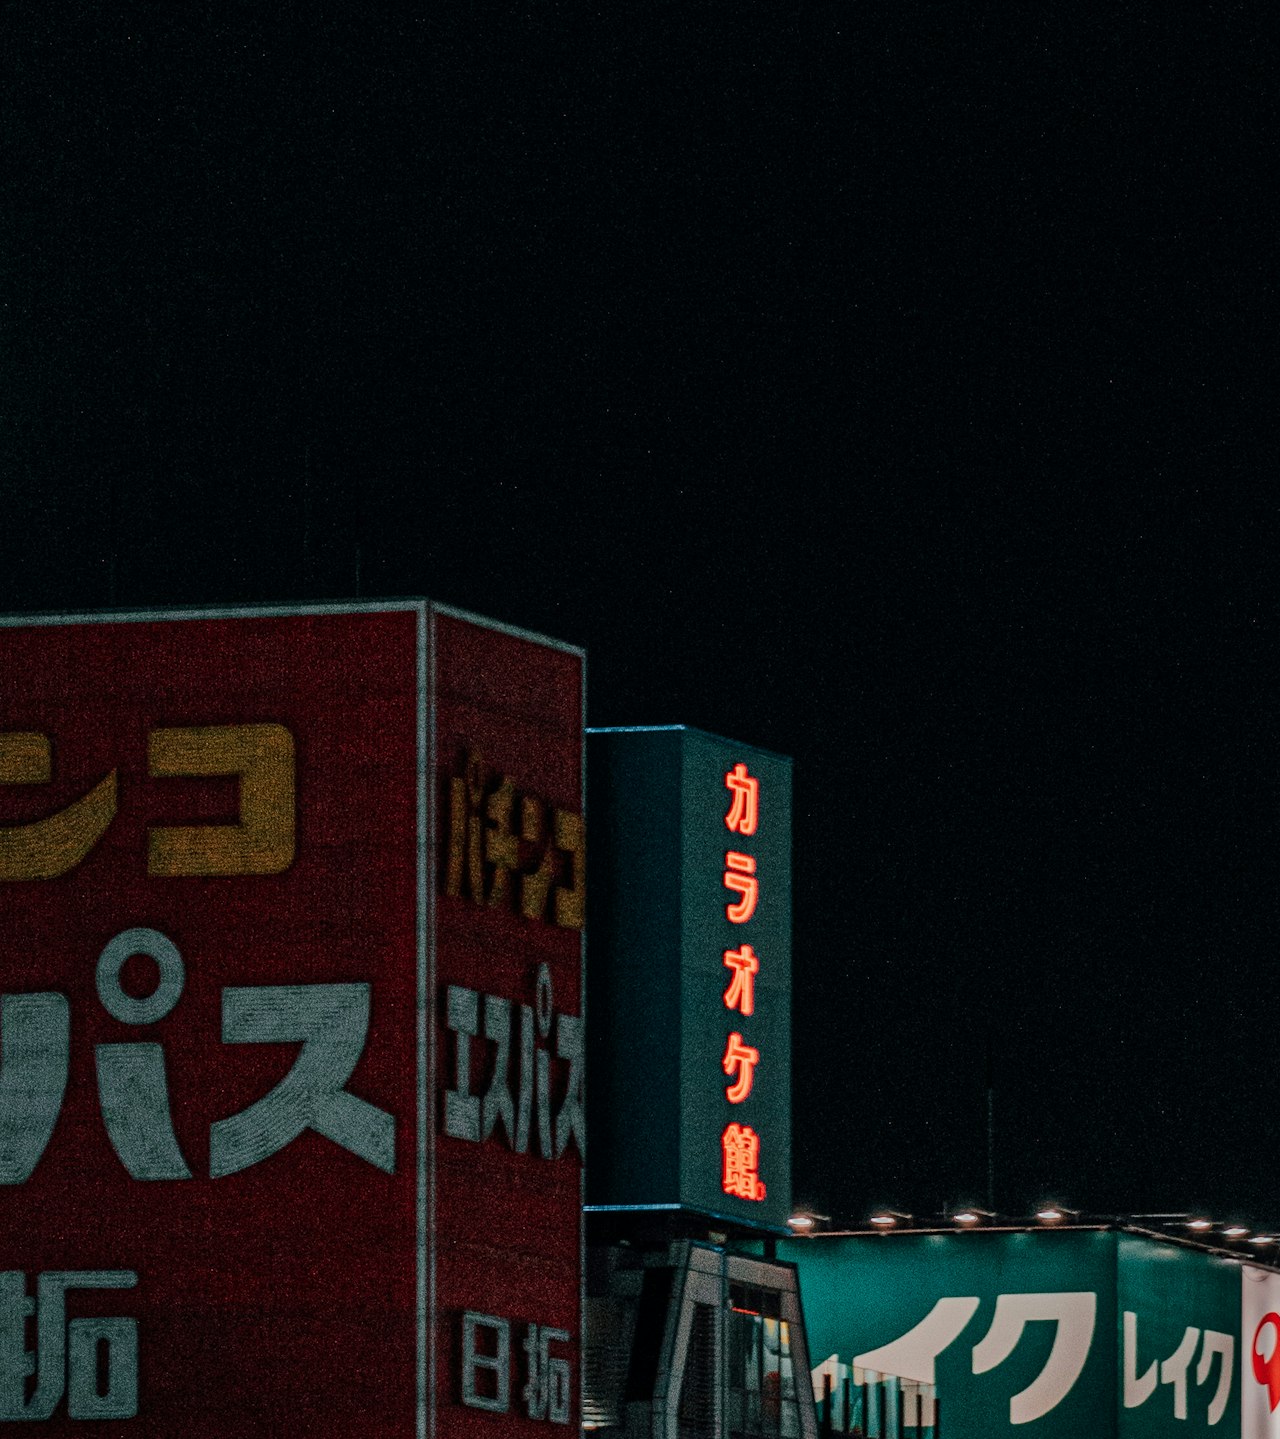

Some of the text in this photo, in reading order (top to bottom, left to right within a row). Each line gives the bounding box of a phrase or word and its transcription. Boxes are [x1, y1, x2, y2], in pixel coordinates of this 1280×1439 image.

[446, 748, 585, 930] パチンコ
[443, 963, 585, 1165] エスパス
[722, 763, 767, 1200] カラオケ館
[461, 1309, 572, 1425] 日拓
[1122, 1311, 1235, 1426] レイク
